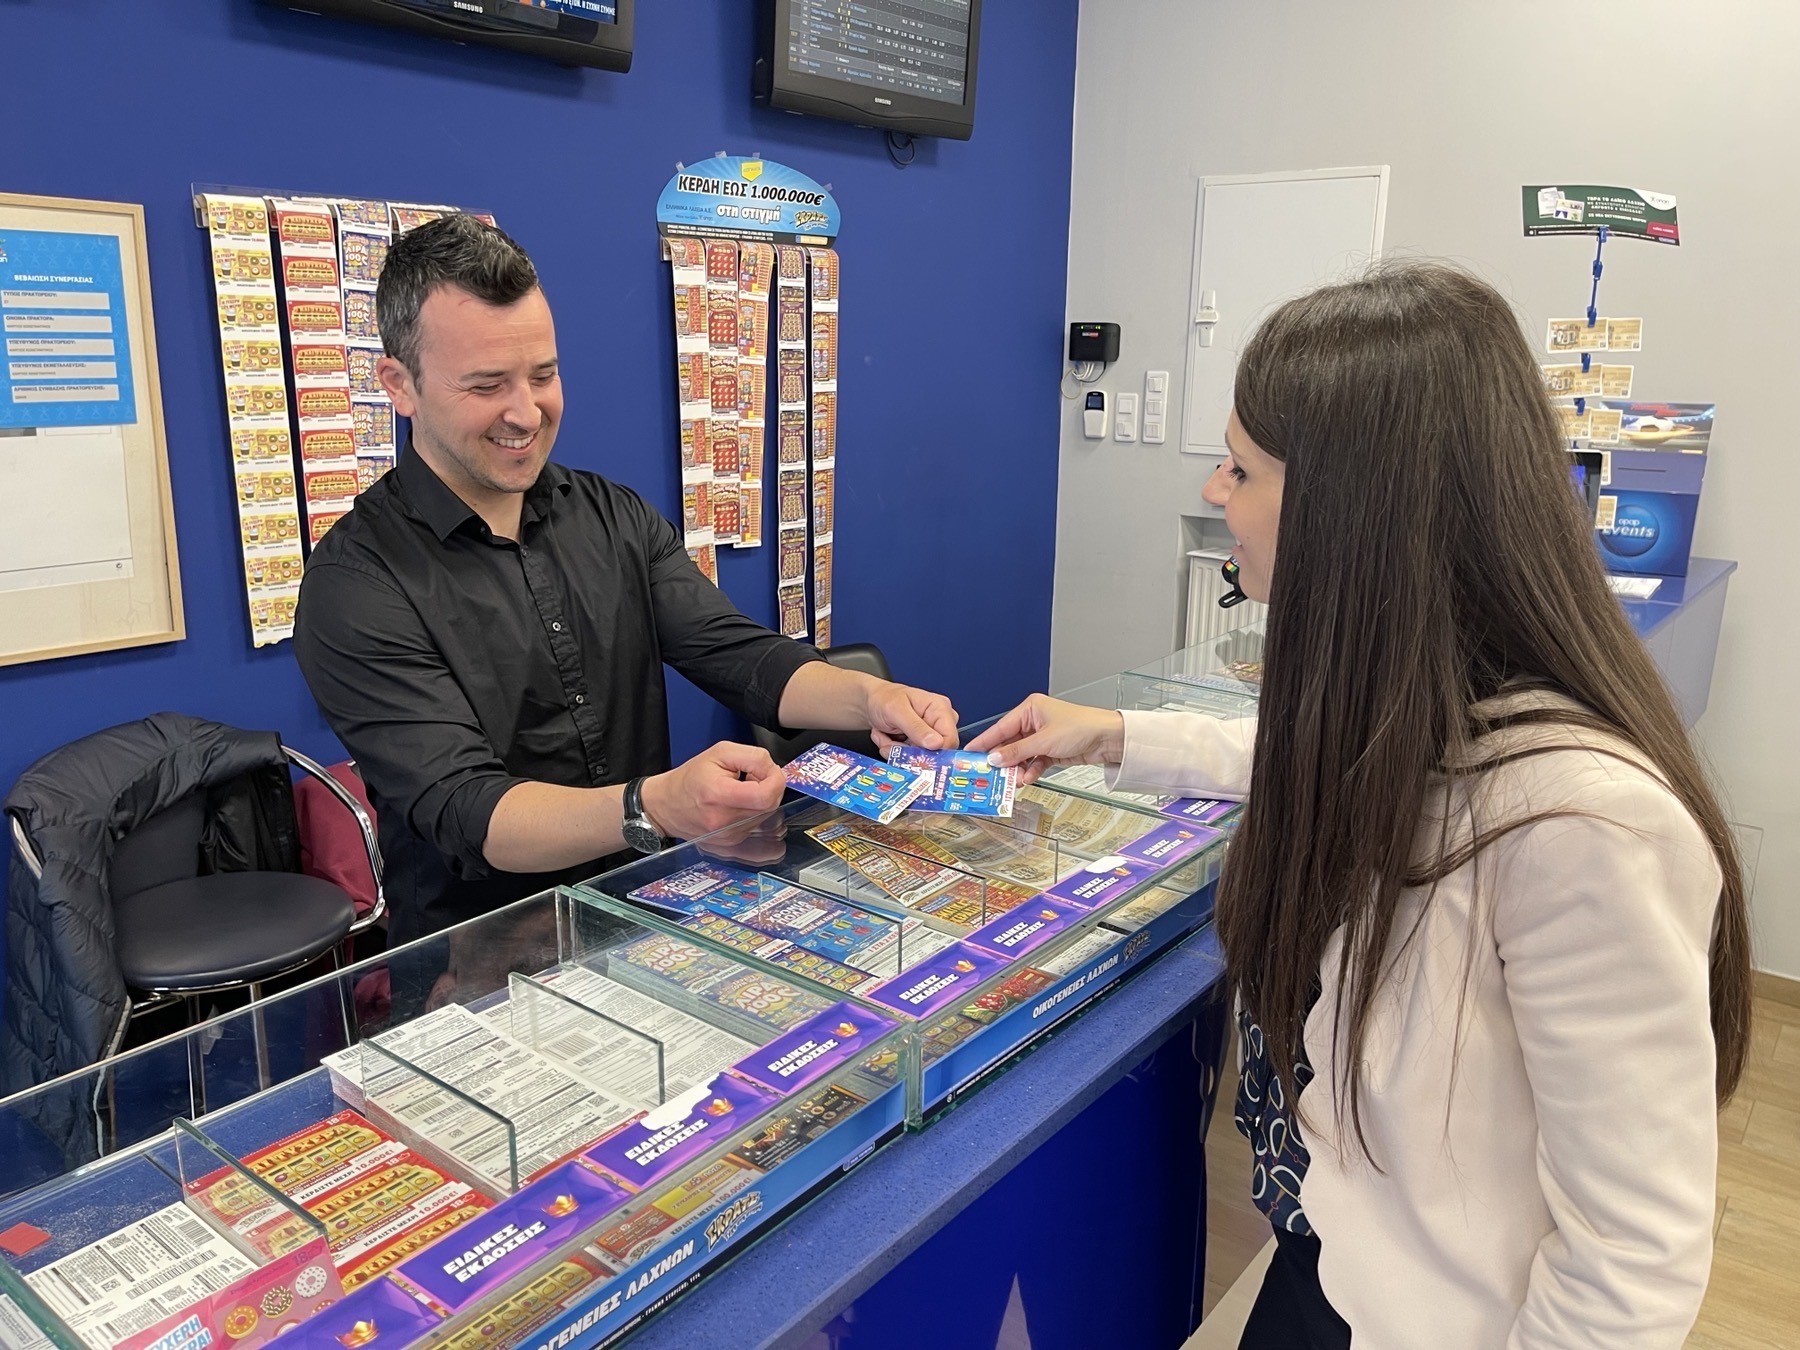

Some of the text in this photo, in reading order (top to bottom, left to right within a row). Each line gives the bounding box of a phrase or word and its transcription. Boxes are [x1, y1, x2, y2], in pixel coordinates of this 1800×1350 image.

[454, 1, 483, 13] SAMSUNG
[679, 176, 825, 205] ΚΕΡΔΗ ΕΩΣ 1.000.000€
[716, 205, 781, 224] στη στιγμή
[14, 274, 49, 282] ΒΕΒΑΙΩΣΗ
[1142, 839, 1170, 856] ΕΙΔΙΚΕΣ
[1151, 838, 1185, 859] ΕΚΔΟΣΕΙΣ
[661, 871, 704, 891] ΧΡΟΝΙΑ
[1072, 877, 1103, 896] ΕΙΔΙΚΕΣ
[1082, 876, 1120, 899] ΕΚΔΟΣΕΙΣ
[767, 900, 809, 922] ΧΡΟΝΙΑ
[777, 903, 816, 926] ΠΟΛΛΑ
[993, 922, 1030, 944] ΕΙΔΙΚΕΣ
[1003, 920, 1047, 947] ΕΚΔΟΣΕΙΣ
[899, 974, 941, 1001] ΕΙΔΙΚΕΣ
[909, 973, 960, 1005] ΕΚΔΟΣΕΙΣ
[1032, 975, 1087, 1018] ΟΙΚΟΓΕΝΕΙΕΣ
[1086, 953, 1119, 983] ΛΑΧΝΩΝ
[768, 1040, 818, 1072] ΕΙΔΙΚΕΣ
[779, 1038, 840, 1077] ΕΚΔΟΣΕΙΣ
[274, 1124, 350, 1162] ΤΥΧΕΡΑ
[625, 1120, 686, 1160] ΕΙΔΙΚΕΣ
[636, 1118, 709, 1166] ΕΚΔΟΣΕΙΣ
[300, 1149, 394, 1200] ΚΕΡΔΙΣΤΕ ΜΕΧΡΙ 10.000€!
[335, 1166, 411, 1207] ΤΥΧΕΡΑ
[363, 1191, 458, 1247] ΚΕΡΔΙΣΤΕ ΜΕΧΡΙ 10.000€!
[400, 1208, 476, 1253] ΤΥΧΕΡΑ
[443, 1223, 519, 1275] ΕΙΔΙΚΕΣ
[455, 1221, 547, 1283] ΕΚΔΟΣΕΙΣ
[625, 1239, 694, 1301] ΛΑΧΝΩΝ
